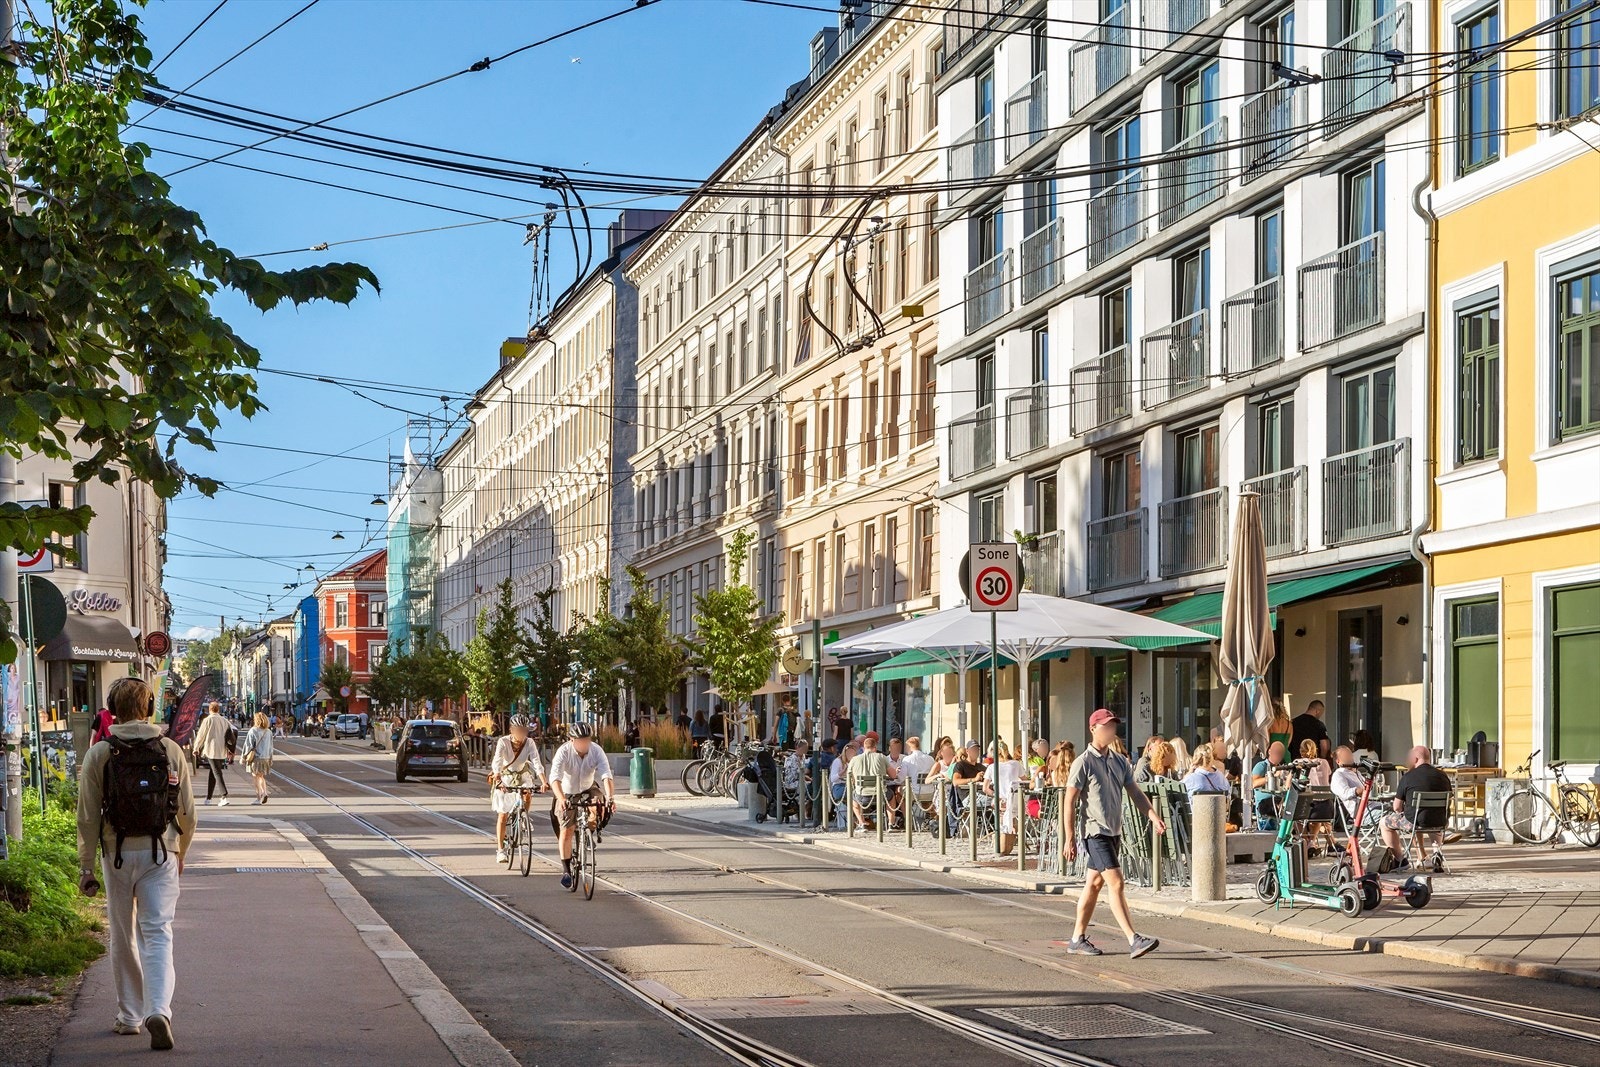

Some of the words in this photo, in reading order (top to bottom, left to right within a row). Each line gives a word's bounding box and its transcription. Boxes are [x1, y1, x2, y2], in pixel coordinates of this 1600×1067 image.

[978, 547, 1010, 560] Sone
[982, 576, 1007, 596] 30
[72, 646, 108, 656] Cocktailbar
[114, 648, 137, 660] Lounge
